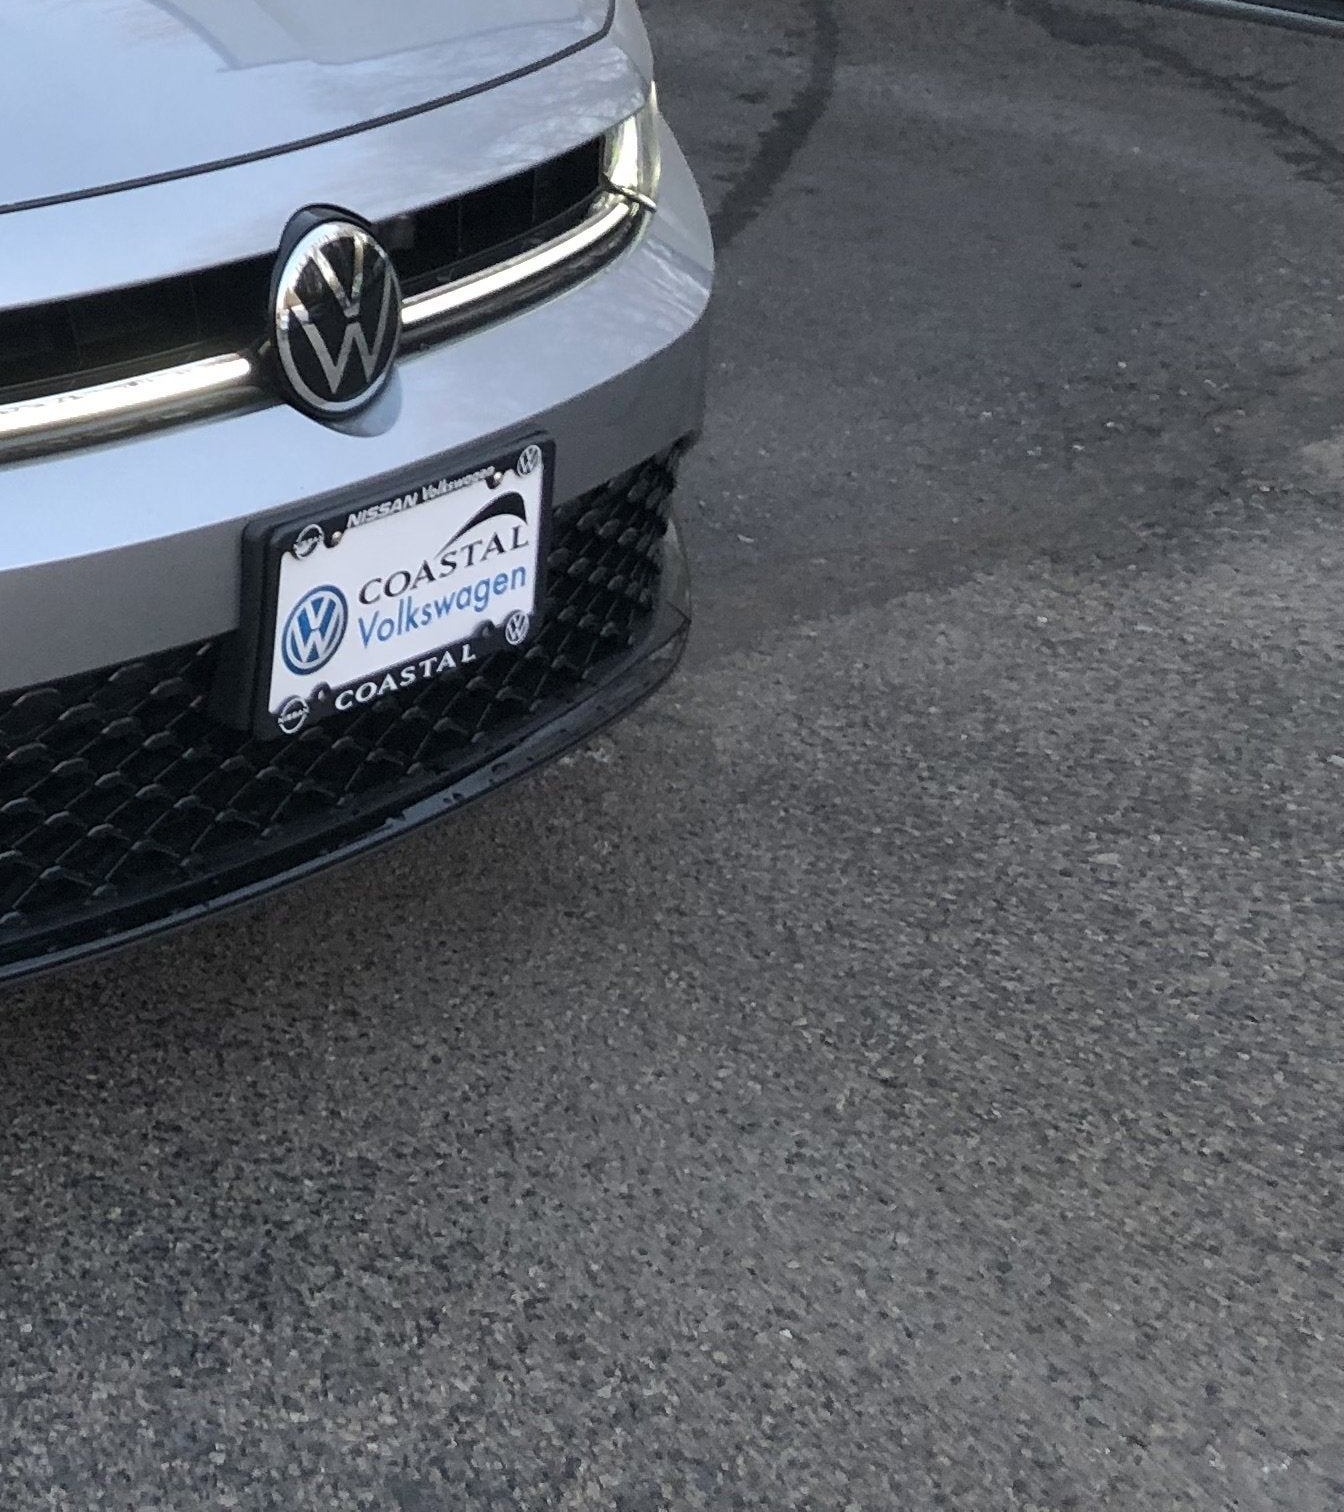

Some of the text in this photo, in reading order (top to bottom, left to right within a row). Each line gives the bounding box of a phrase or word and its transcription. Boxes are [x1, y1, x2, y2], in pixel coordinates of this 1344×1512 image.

[346, 491, 419, 529] NISSAN
[358, 524, 530, 606] COASTAL
[358, 566, 526, 649] Volkswagen
[334, 643, 477, 711] COASTAL
